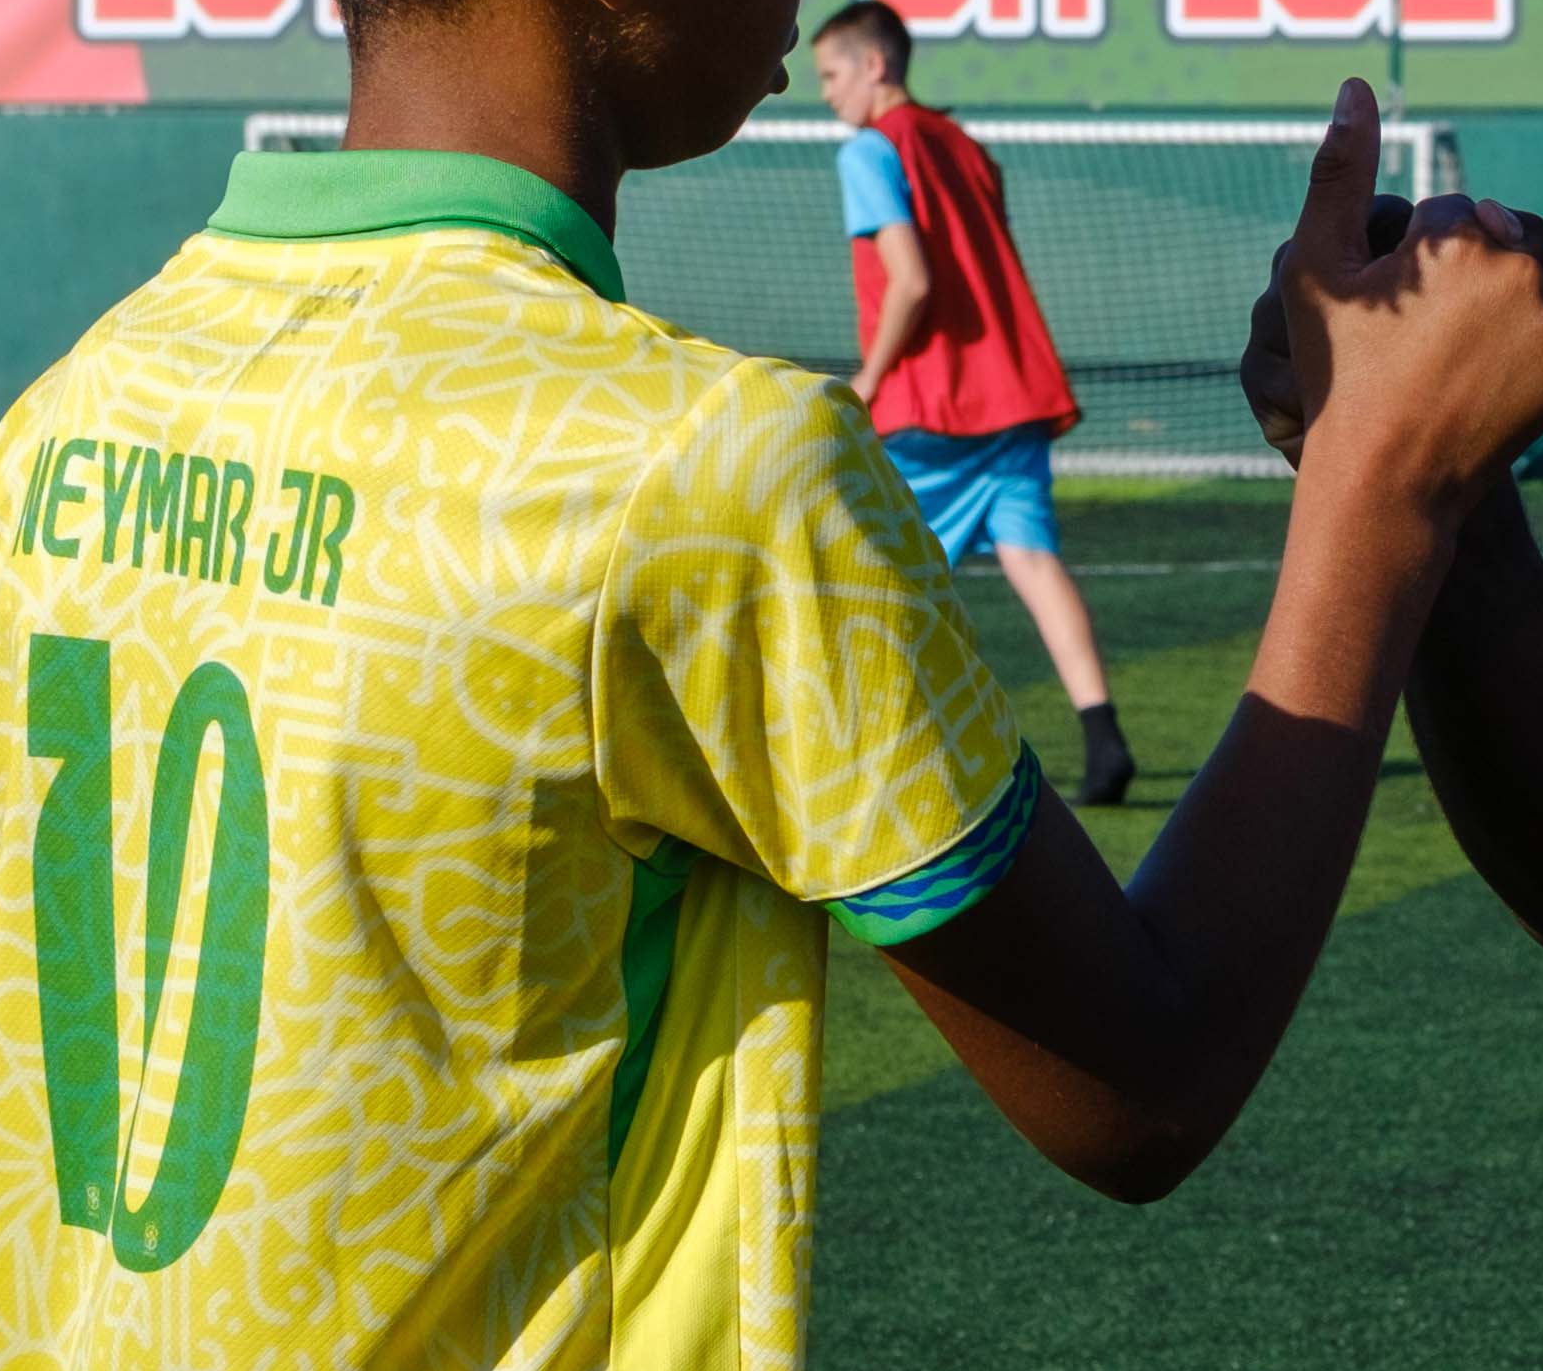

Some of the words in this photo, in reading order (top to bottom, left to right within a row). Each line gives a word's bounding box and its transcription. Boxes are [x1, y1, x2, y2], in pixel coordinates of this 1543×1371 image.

[12, 436, 255, 587] NEYMAR
[263, 468, 357, 608] JR
[27, 632, 271, 1273] 10
